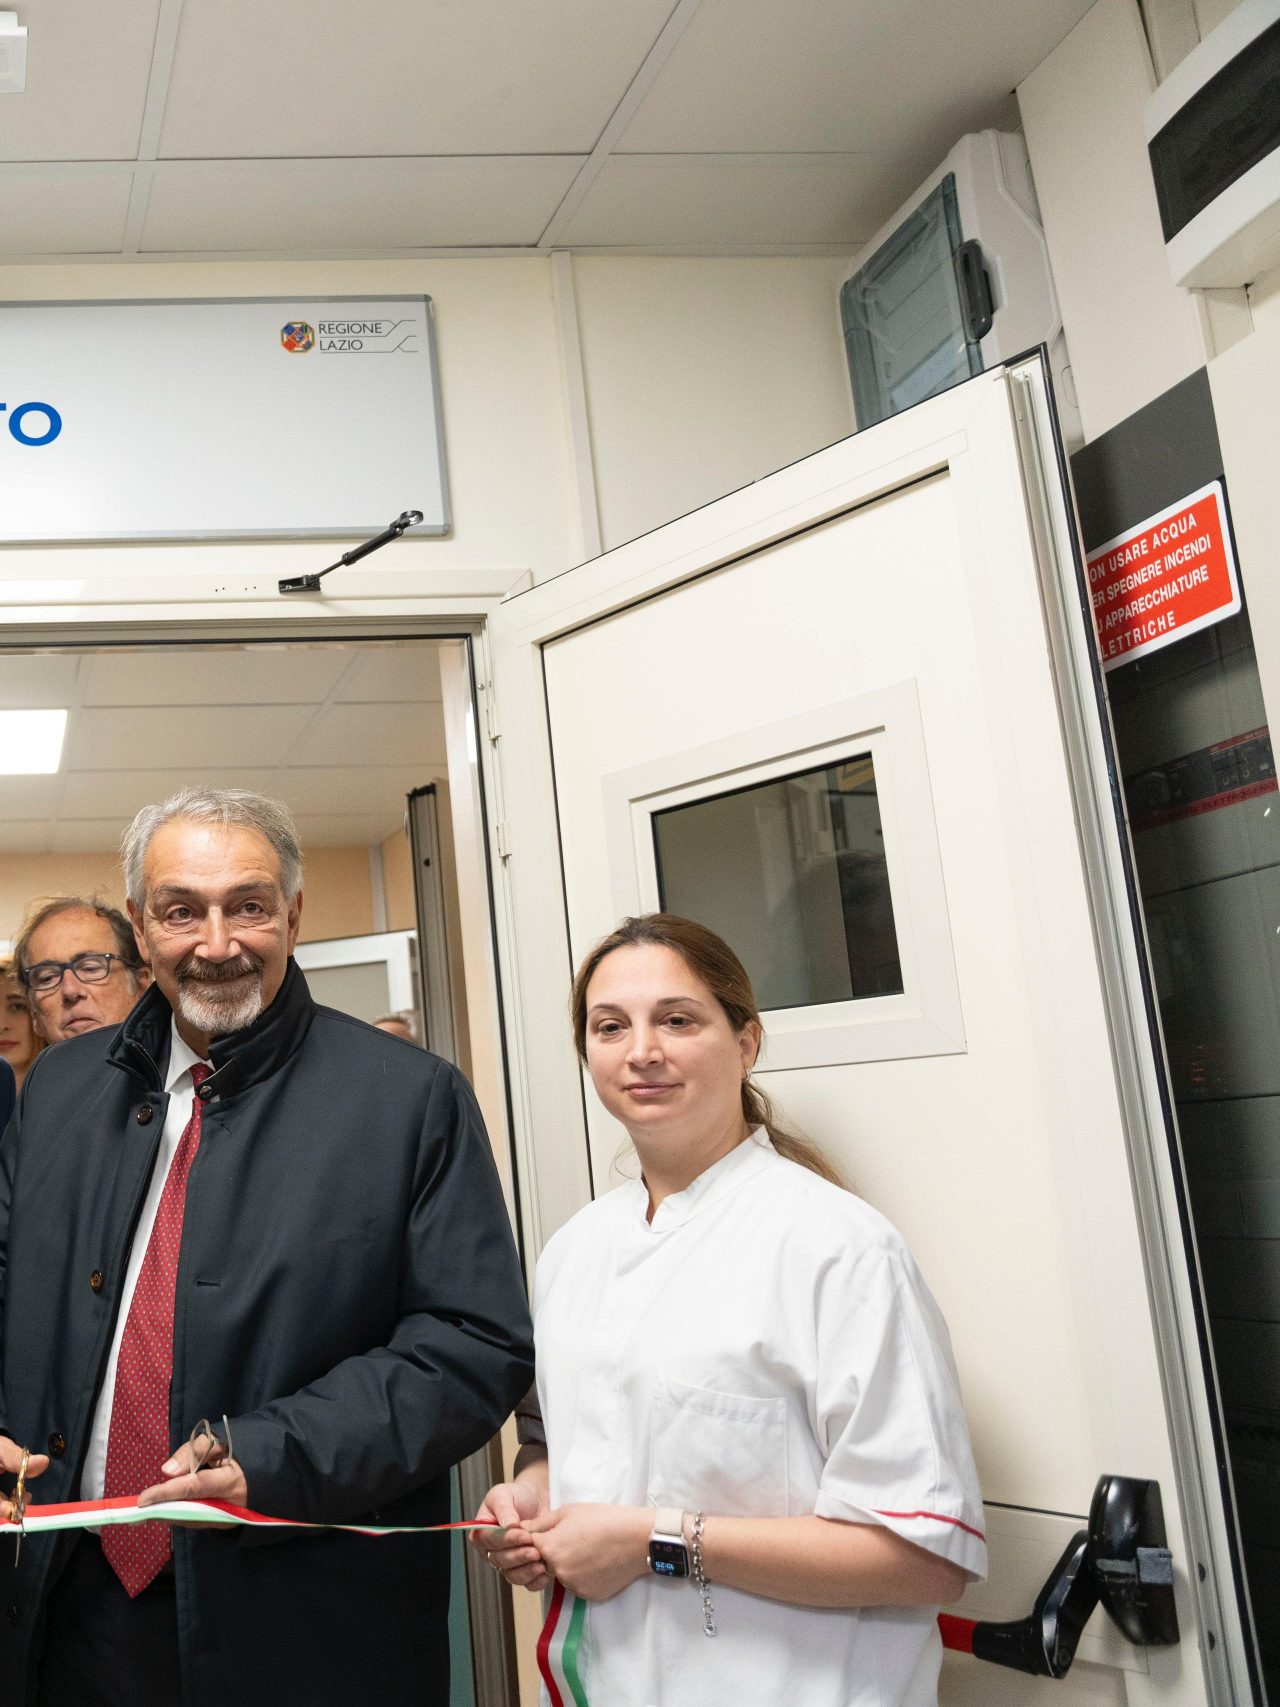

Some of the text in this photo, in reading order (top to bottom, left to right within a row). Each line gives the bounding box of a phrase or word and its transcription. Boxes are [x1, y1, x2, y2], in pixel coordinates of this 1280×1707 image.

[318, 322, 383, 335] REGIONE
[319, 339, 363, 351] LAZIO
[1088, 512, 1197, 582] ON USARE ACQUA
[1091, 533, 1212, 609] ER SPEGNERE INCENDI
[1105, 565, 1209, 630] APPARECCHIATURE
[1101, 610, 1176, 659] LETTRICHE
